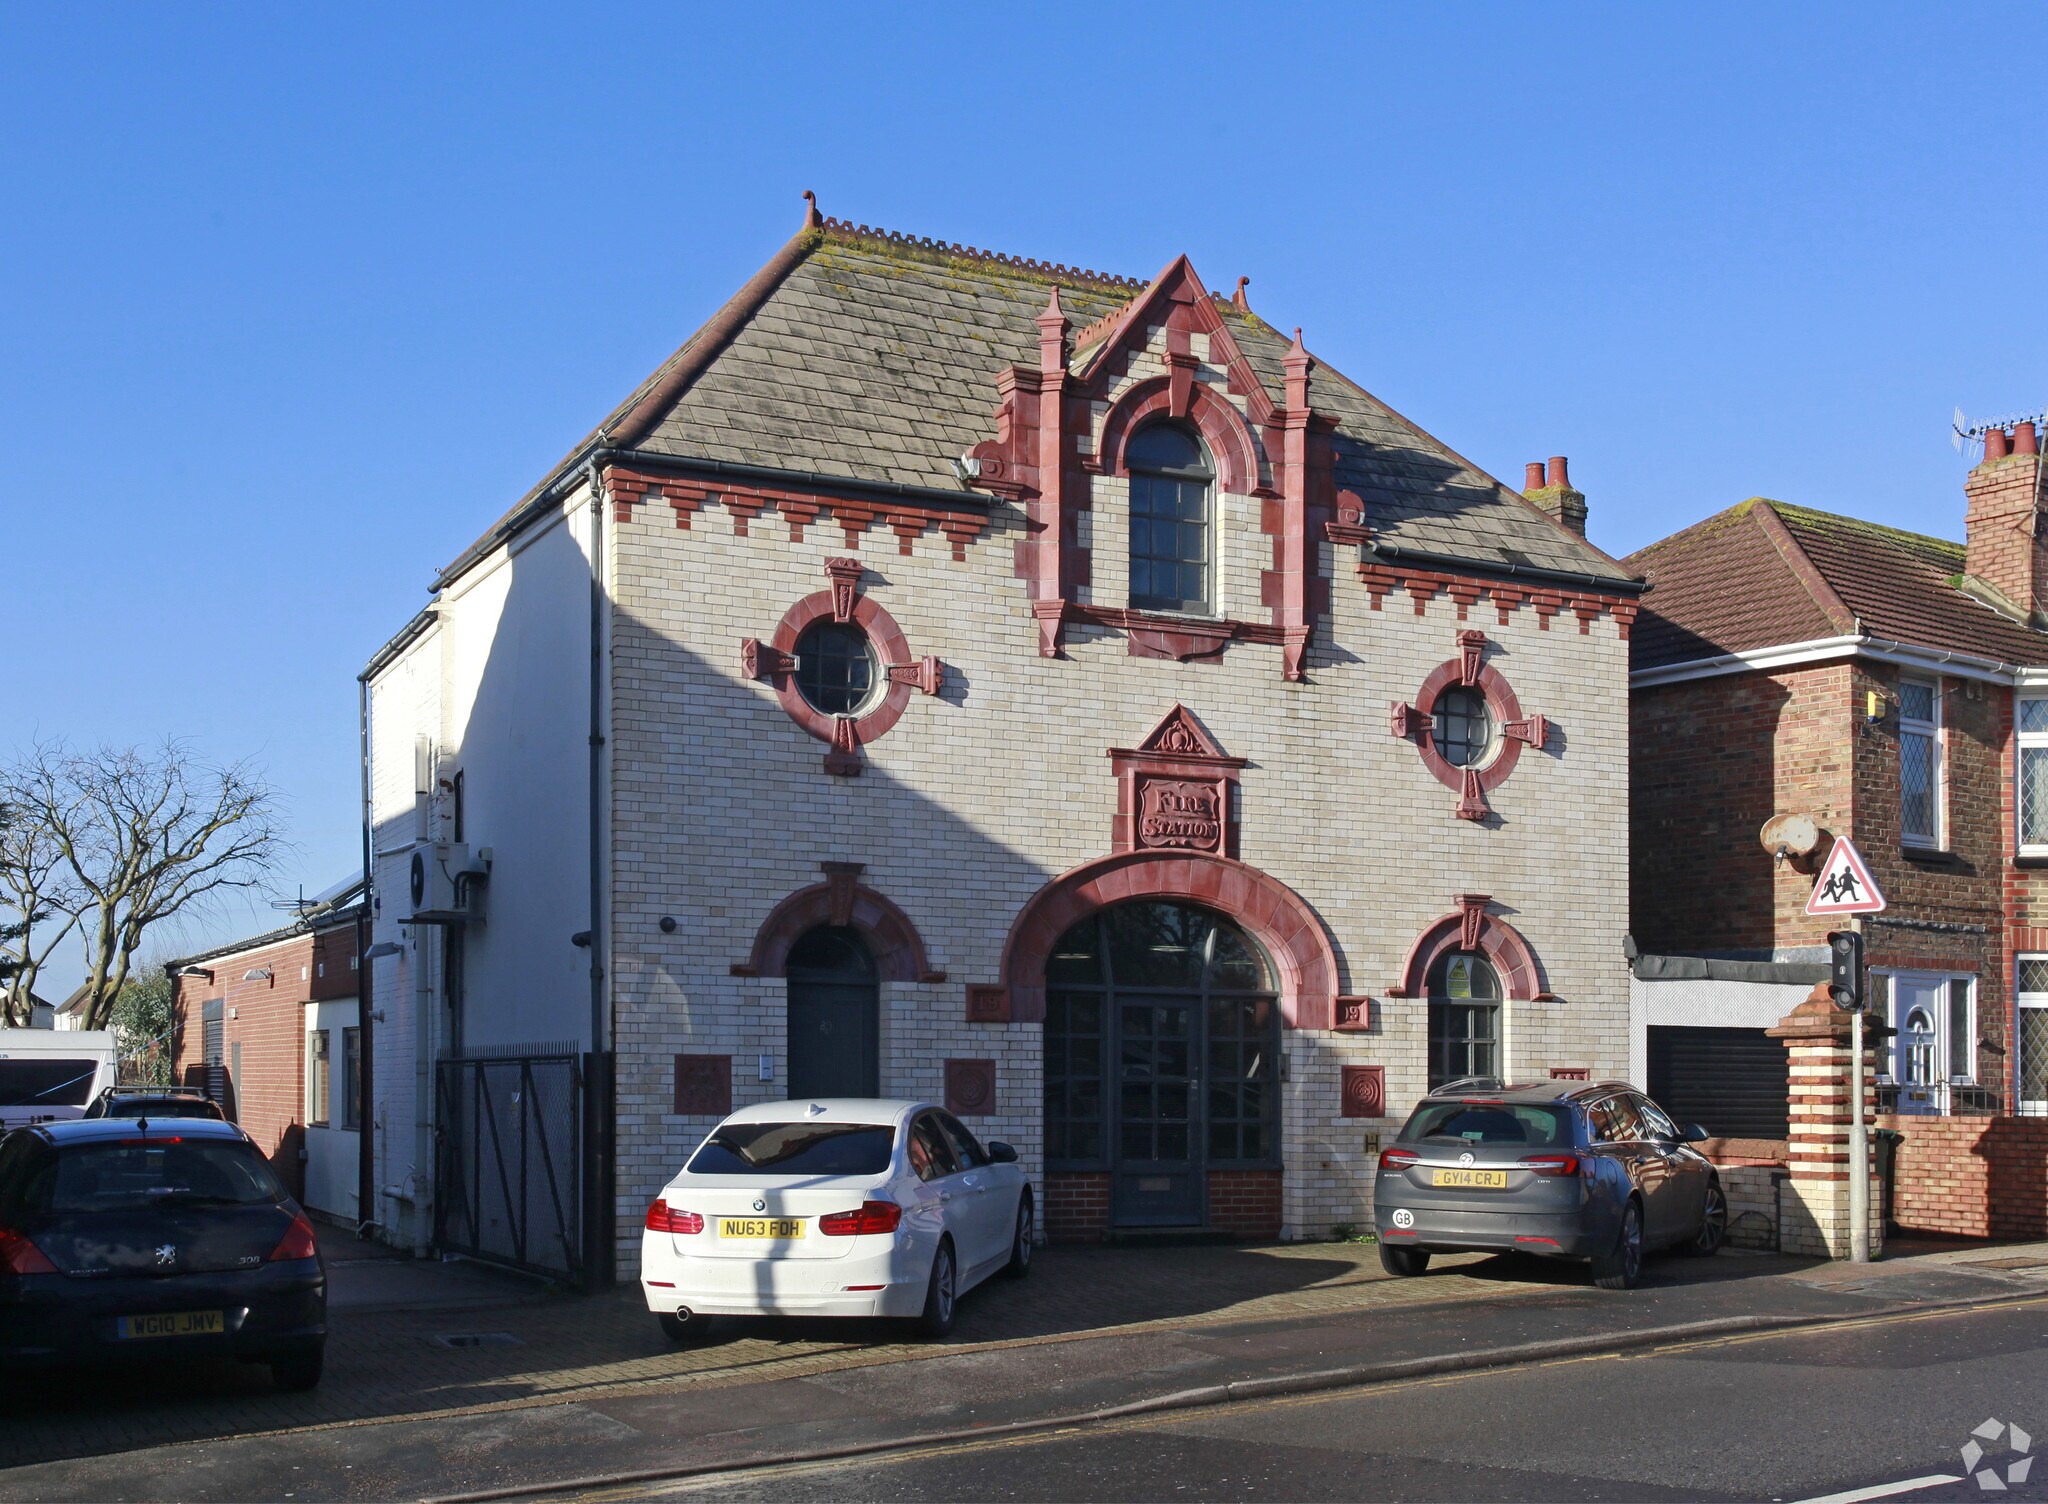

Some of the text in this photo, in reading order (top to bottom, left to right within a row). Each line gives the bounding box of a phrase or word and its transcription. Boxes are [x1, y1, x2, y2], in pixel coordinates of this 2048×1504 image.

[1155, 789, 1206, 813] FIRE
[1143, 817, 1217, 838] STATION
[1365, 1134, 1379, 1154] H
[1443, 1172, 1472, 1184] GY14
[1475, 1172, 1502, 1186] CRJ
[1395, 1212, 1411, 1225] GB
[726, 1221, 765, 1236] NU63
[238, 1255, 260, 1264] 308
[134, 1313, 215, 1334] WG10 JMV
